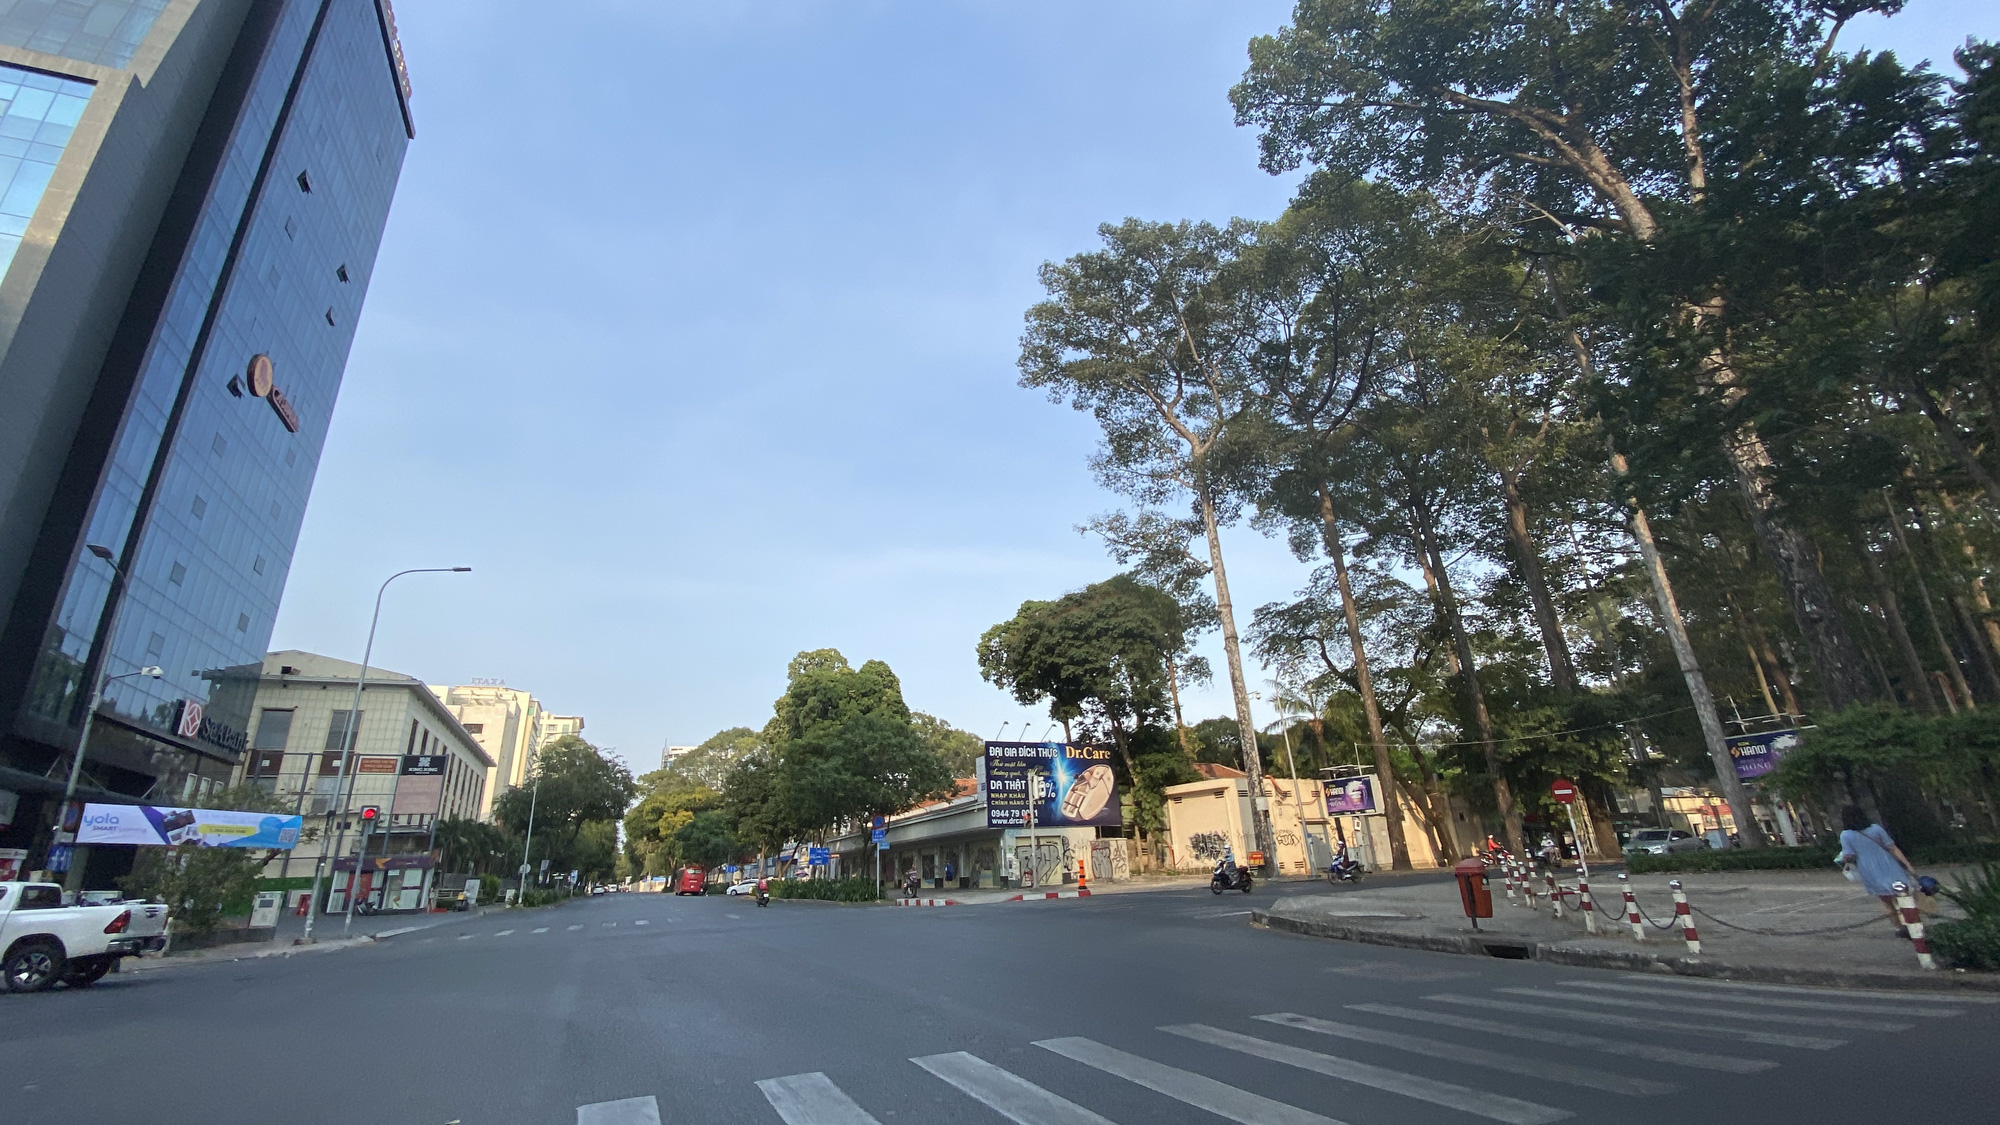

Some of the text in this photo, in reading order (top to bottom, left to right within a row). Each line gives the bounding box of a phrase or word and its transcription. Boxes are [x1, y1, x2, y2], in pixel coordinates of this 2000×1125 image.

[989, 745, 1059, 759] ĐẠI GIA ĐÍCH THỰC
[1065, 745, 1111, 759] Dr.Care
[990, 780, 1002, 790] DA
[1005, 779, 1026, 792] THẬT
[84, 813, 119, 826] yola
